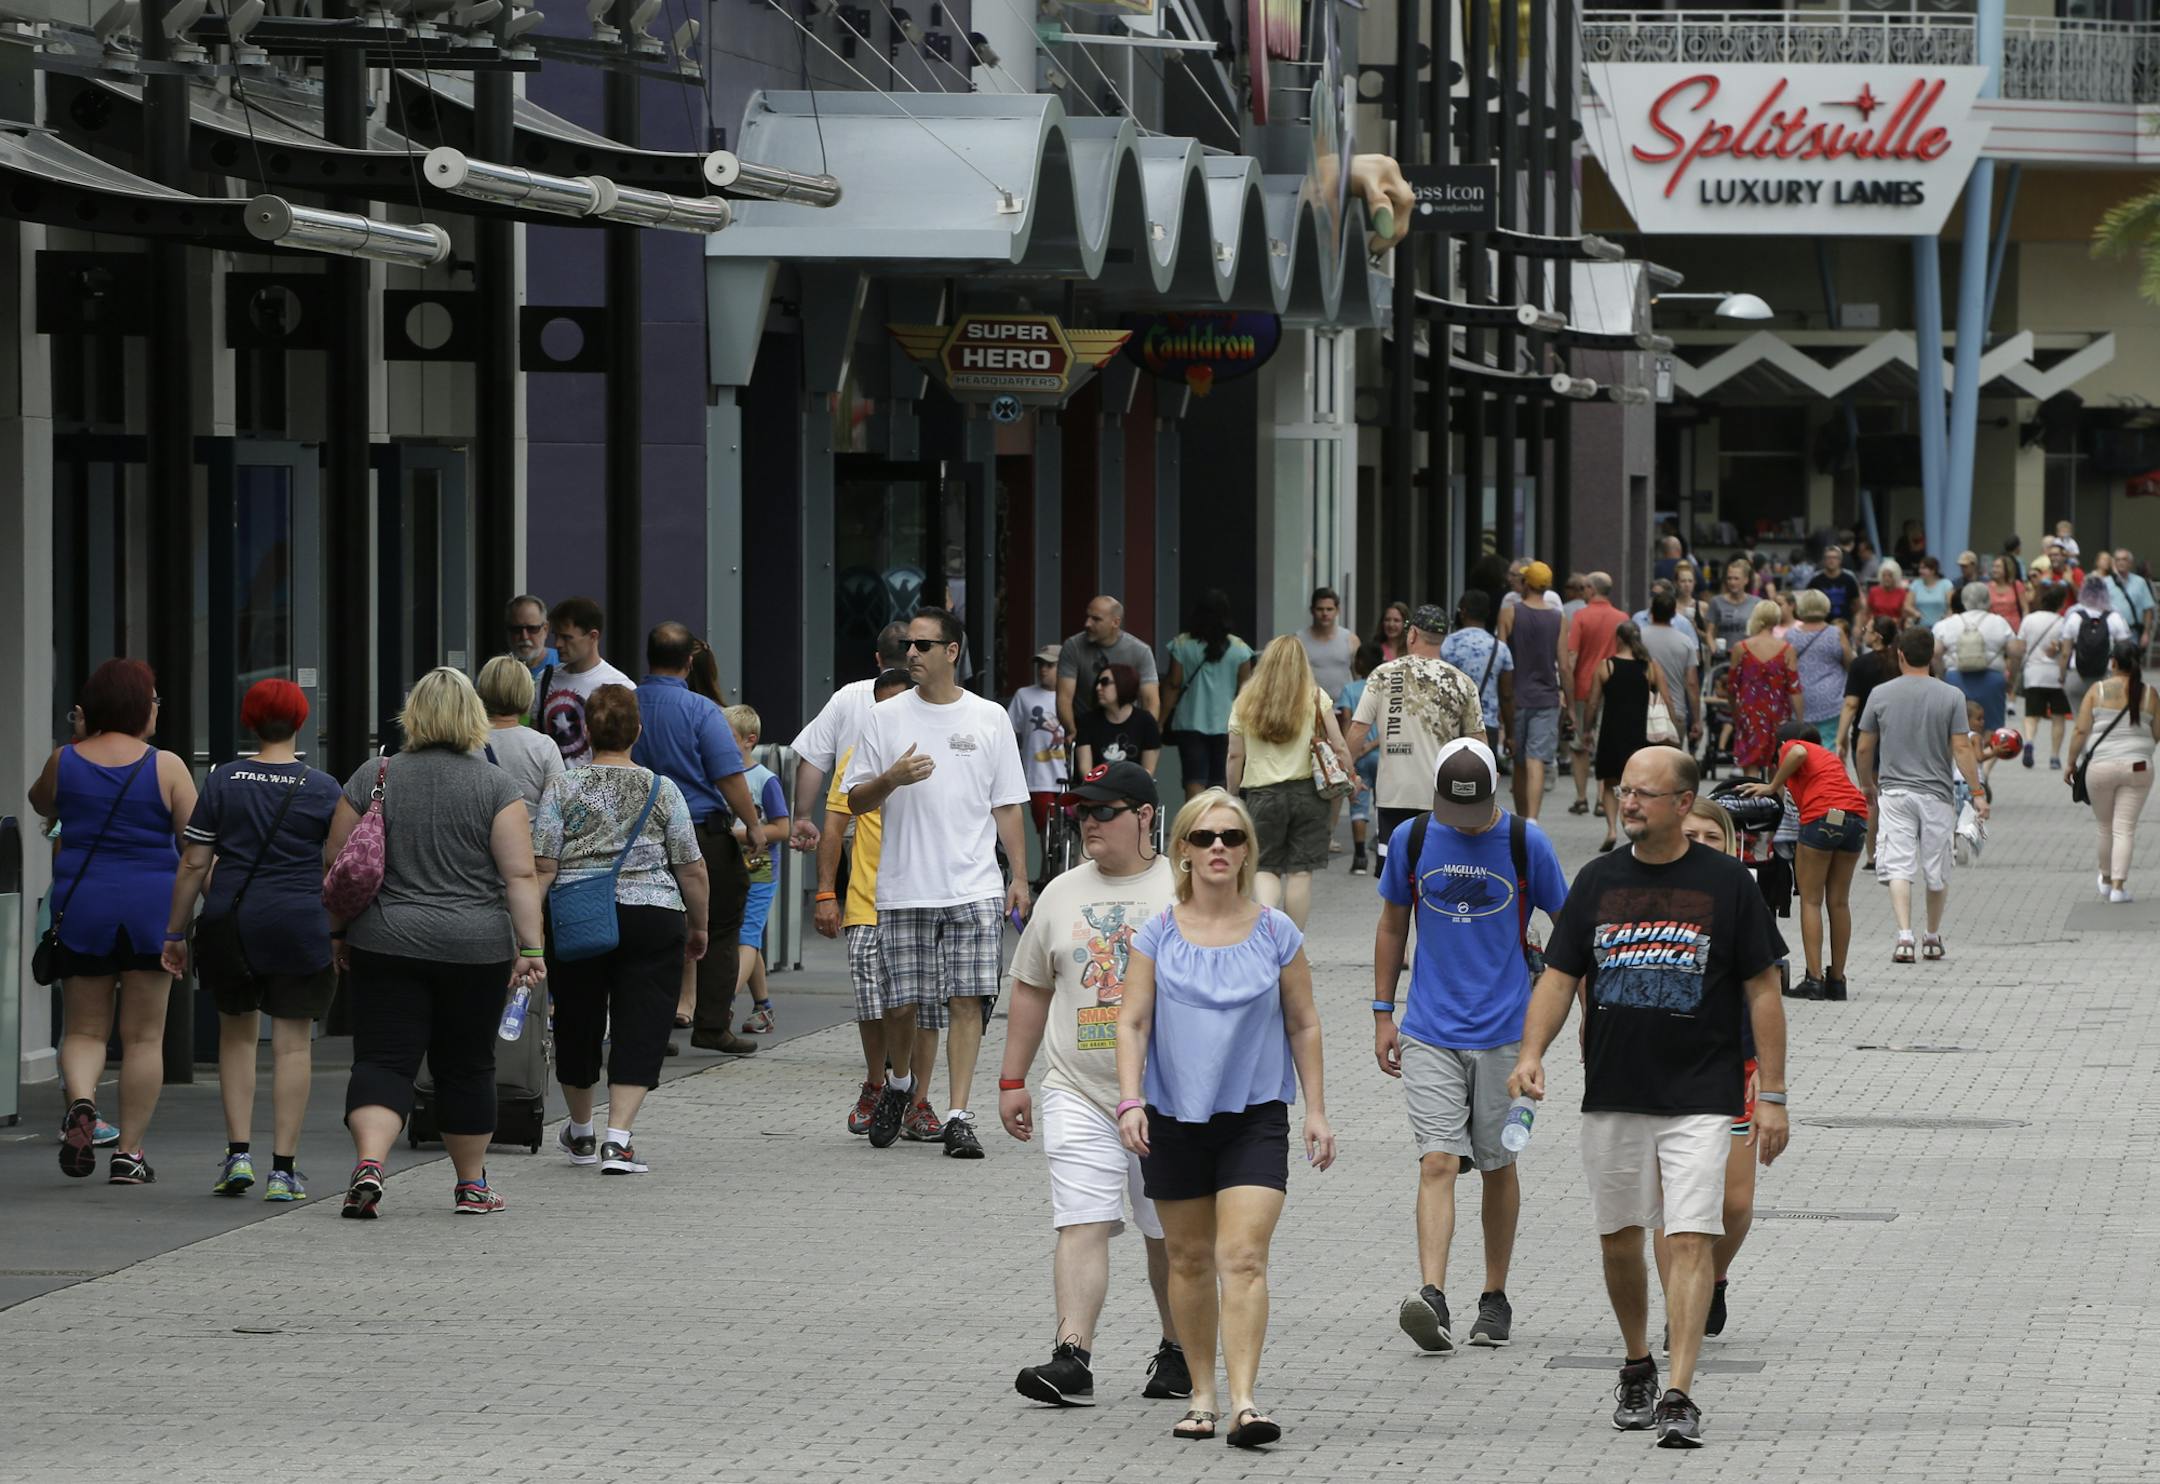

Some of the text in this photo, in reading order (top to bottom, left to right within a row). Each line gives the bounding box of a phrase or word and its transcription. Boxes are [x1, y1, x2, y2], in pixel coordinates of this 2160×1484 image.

[1632, 74, 1952, 199] Splitsville
[1446, 183, 1484, 200] icon
[1699, 179, 1926, 207] LUXURY LANES
[967, 323, 1048, 341] SUPER
[1143, 322, 1256, 370] Cauldron
[962, 347, 1051, 370] HERO
[956, 375, 1056, 387] HEADQUARTERS
[1390, 671, 1404, 694] FOR
[1389, 697, 1402, 714] US
[230, 771, 268, 782] STAR
[1443, 864, 1487, 876] MAGELLAN
[1601, 920, 1702, 948] CAPTAIN
[1601, 942, 1697, 970] AMERICA
[1079, 1024, 1118, 1041] CRAS
